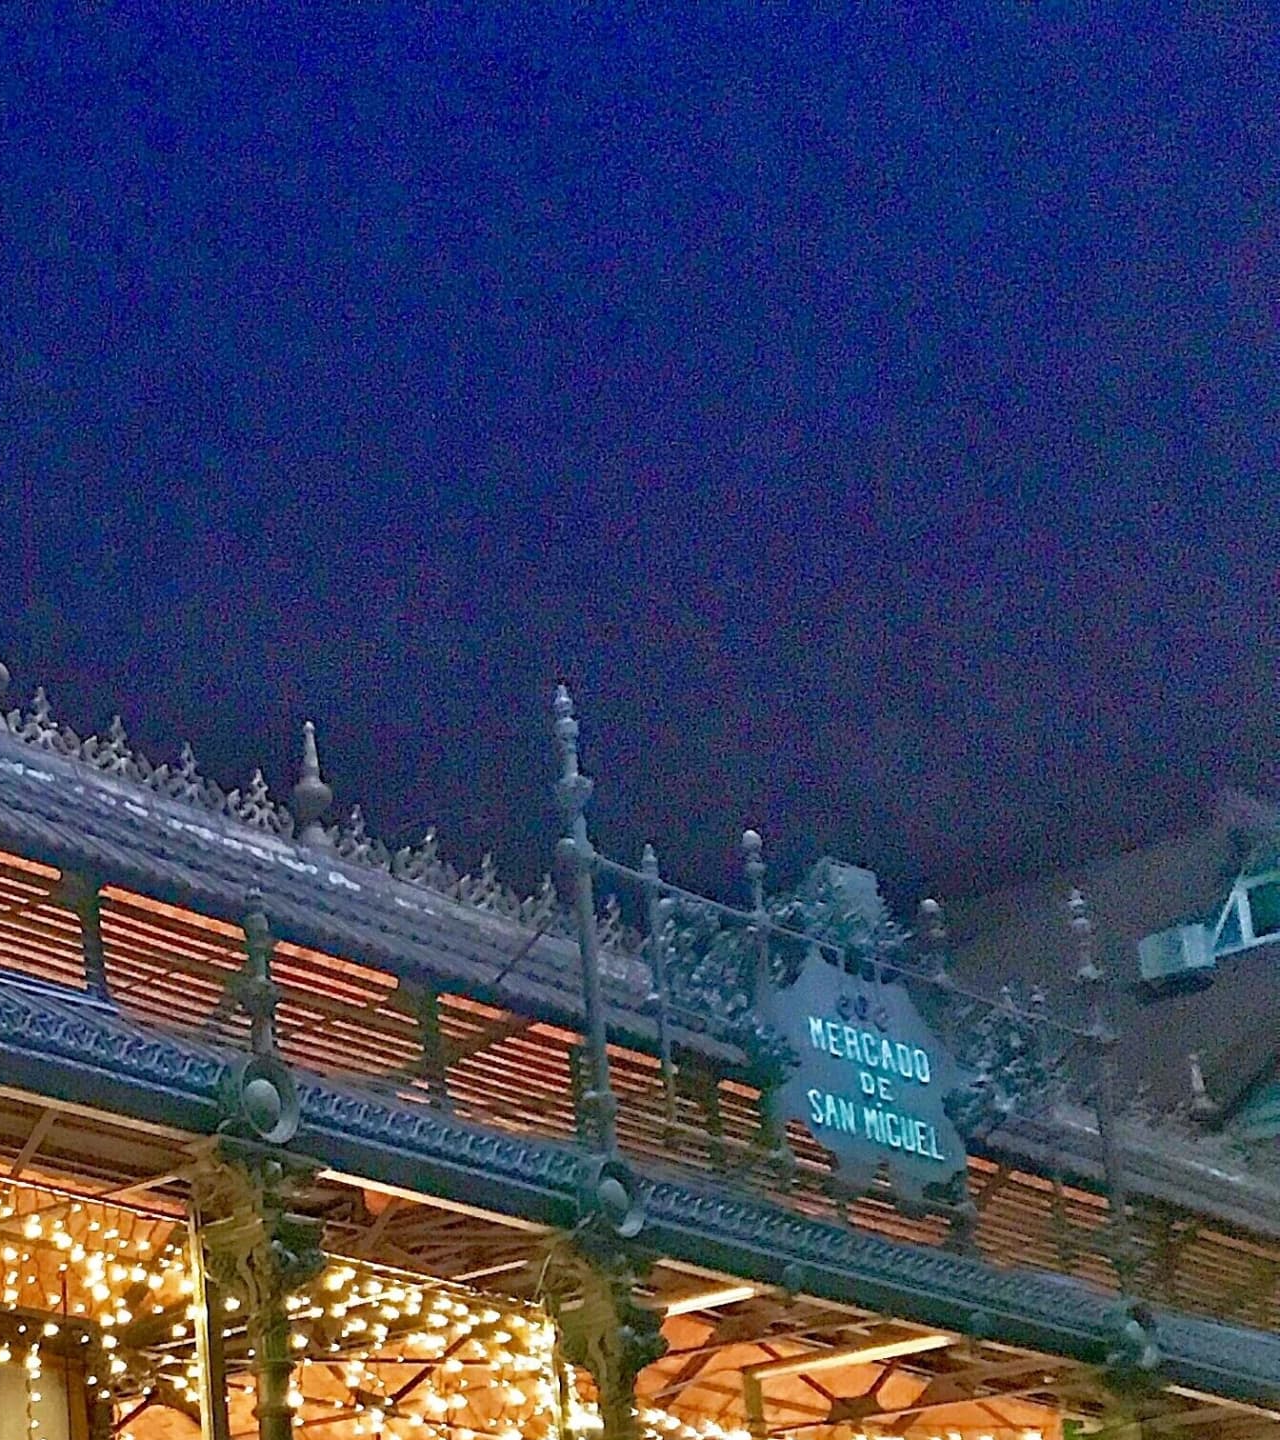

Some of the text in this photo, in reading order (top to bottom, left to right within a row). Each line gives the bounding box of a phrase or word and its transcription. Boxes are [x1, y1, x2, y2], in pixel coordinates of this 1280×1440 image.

[808, 1016, 930, 1084] MERCADO
[860, 1071, 893, 1101] DE
[807, 1089, 945, 1160] SAN MIGUEL
